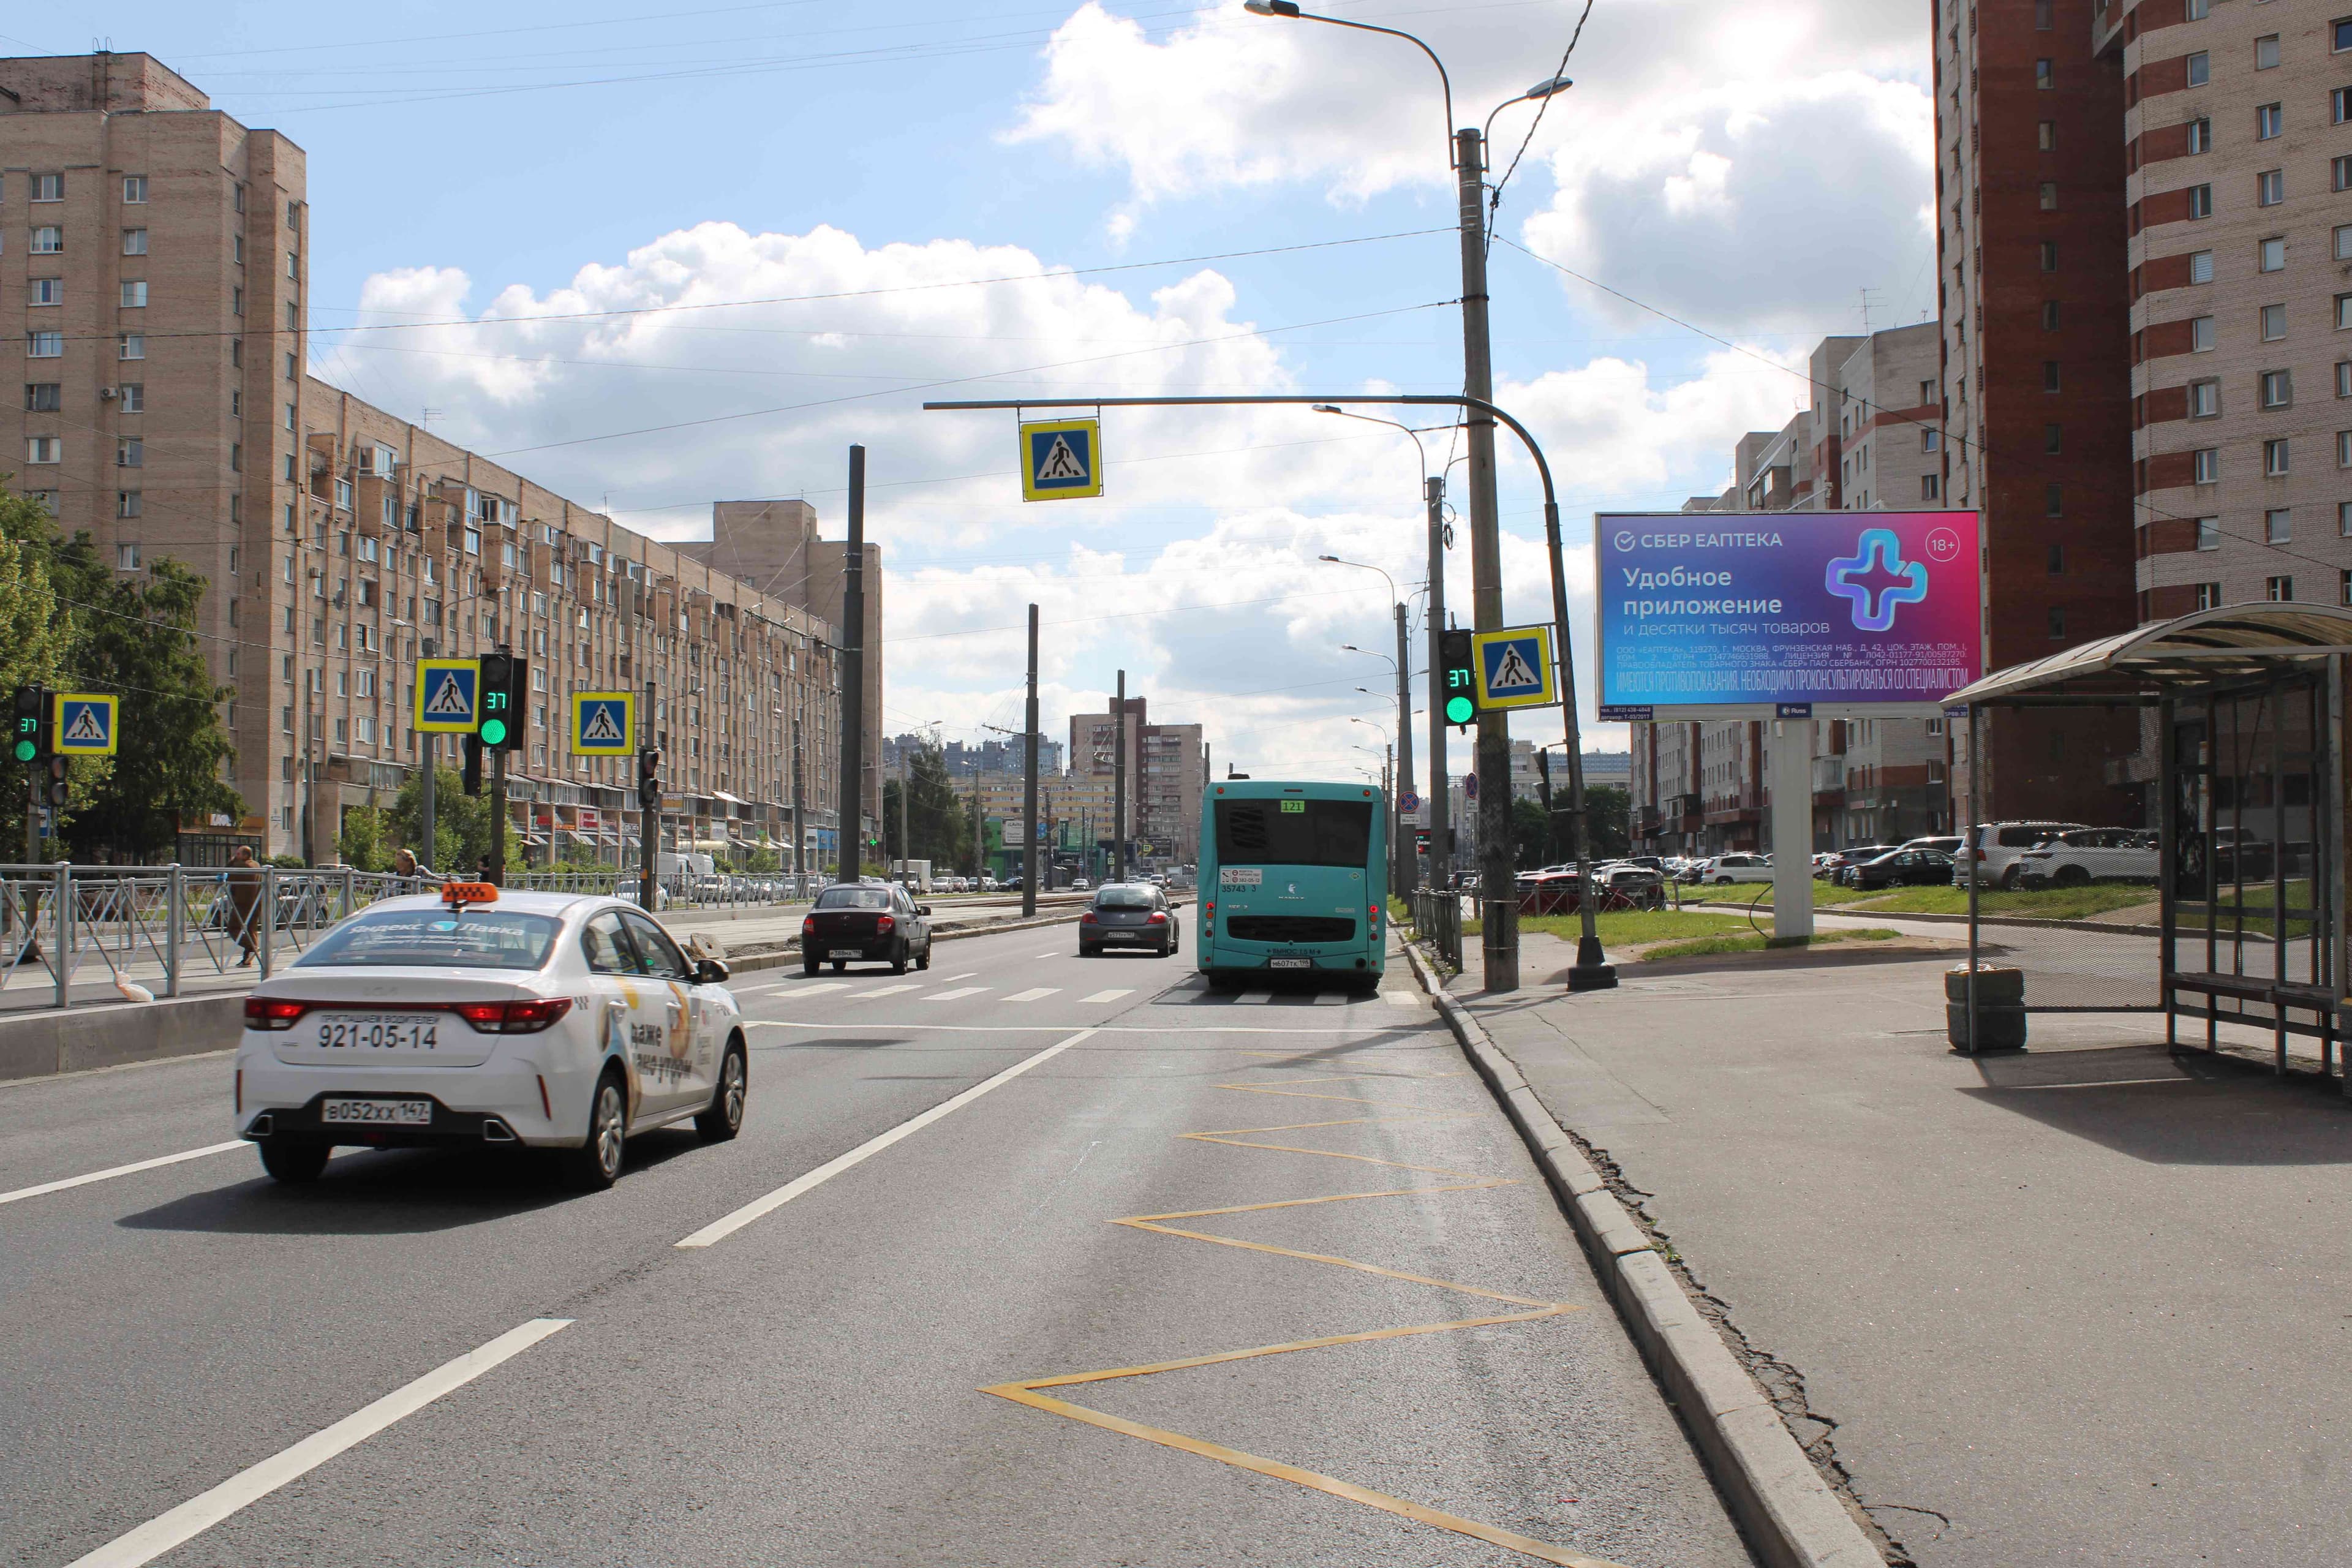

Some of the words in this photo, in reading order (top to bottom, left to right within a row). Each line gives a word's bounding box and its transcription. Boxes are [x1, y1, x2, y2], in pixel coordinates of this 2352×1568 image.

[1641, 534, 1691, 548] СБЕР
[1695, 533, 1784, 548] ЕАПТЕКА
[1932, 539, 1955, 551] 18+
[1622, 565, 1732, 589] Удобное
[1624, 599, 1782, 619] приложение
[1624, 625, 1633, 635] и
[1638, 624, 1705, 636] десятки
[1709, 623, 1757, 635] тысяч
[1762, 622, 1830, 636] товаров
[1784, 652, 1829, 660] ЛИЦЕНЗИЯ
[1449, 669, 1469, 687] 37
[1617, 671, 1653, 692] ИМЕЮТСЯ
[1656, 671, 1740, 692] ПРОТИВОПОКАЗАНИЯ.
[1741, 670, 1794, 694] НЕОБХОДИМО
[1796, 669, 1893, 690] ПРОКОНСУЛЬТИРОВАТЬСЯ
[1894, 668, 1904, 690] СО
[1905, 668, 1968, 693] СПЕЦИАЛИСТОМ
[487, 692, 507, 709] 37
[20, 718, 37, 732] 37
[1283, 802, 1302, 811] 121
[348, 924, 424, 934] Яндекс
[459, 923, 524, 936] Лавка
[318, 1024, 437, 1049] 921-05-14
